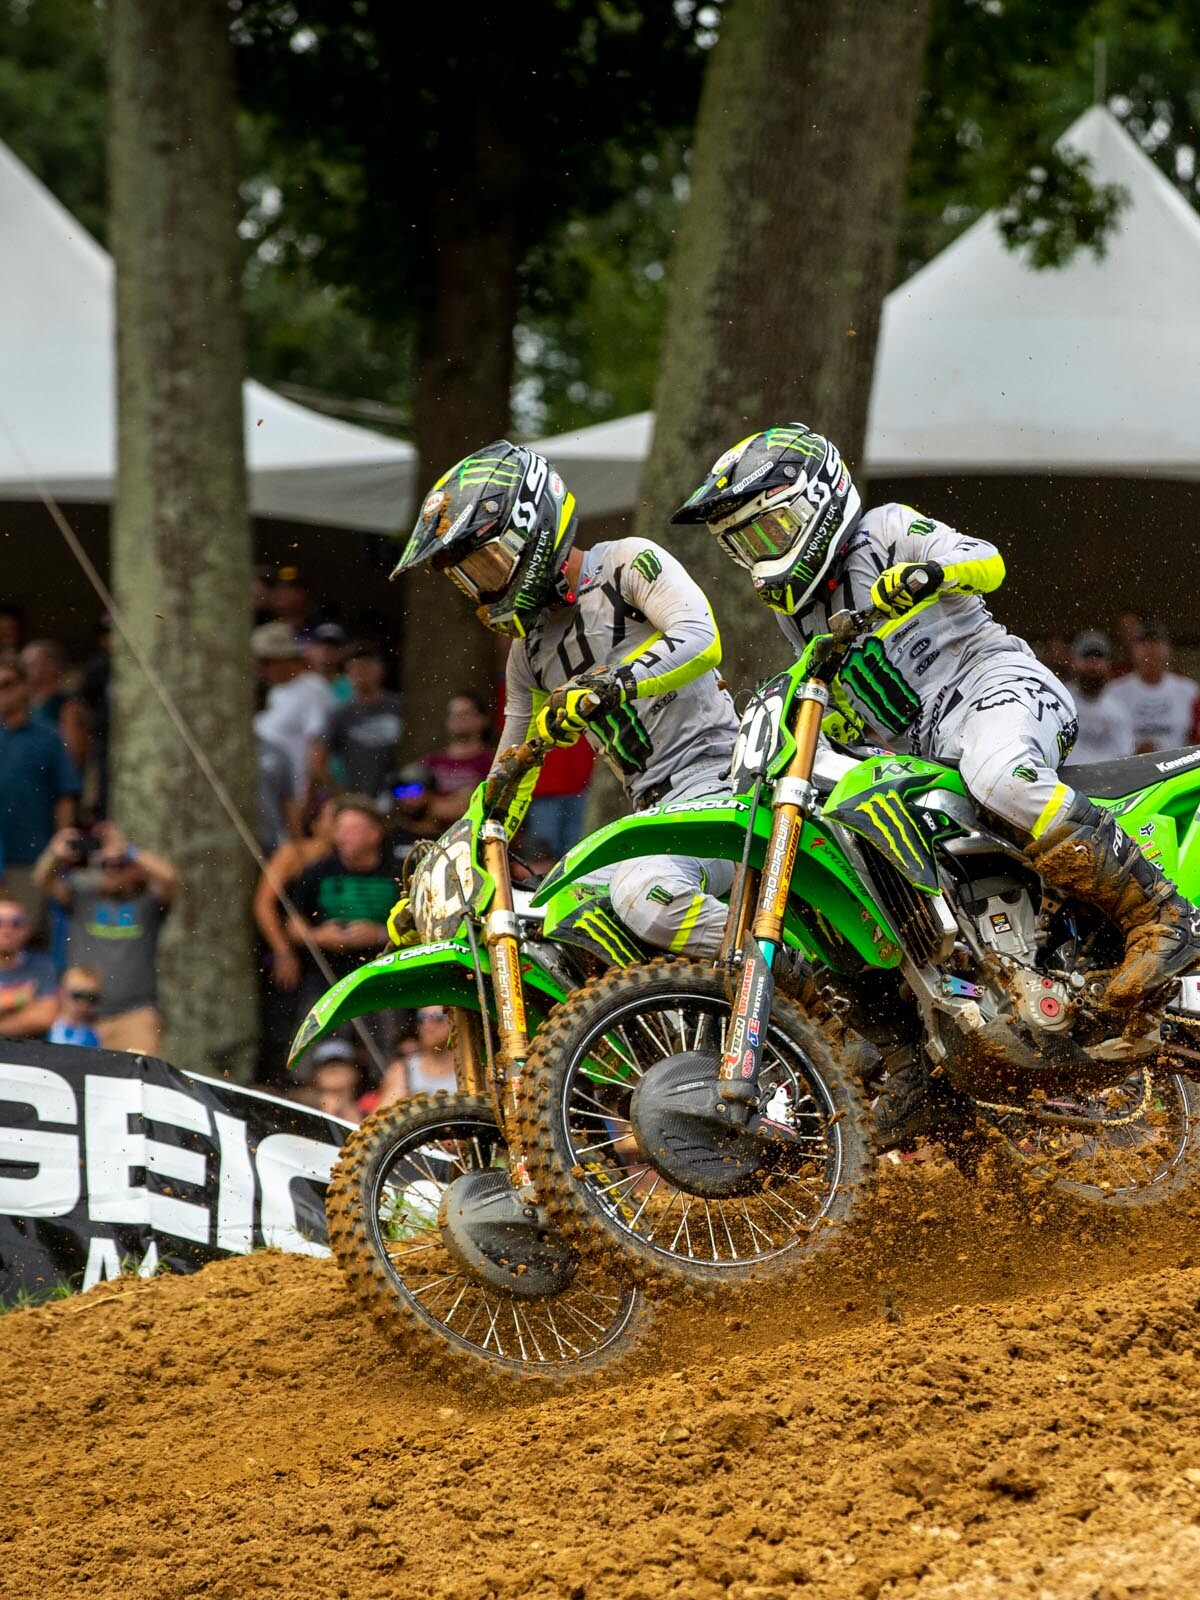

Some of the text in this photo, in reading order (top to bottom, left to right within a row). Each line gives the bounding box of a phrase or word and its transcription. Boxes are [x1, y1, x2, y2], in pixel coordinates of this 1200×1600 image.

[522, 530, 550, 590] MONSTER
[804, 505, 838, 562] MONSTER
[912, 640, 928, 656] BELL
[664, 799, 750, 813] CIRCUIT
[763, 814, 790, 912] PRO CIRCUIT
[785, 822, 800, 881] SHOWA
[399, 940, 471, 961] CIRCUIT
[510, 945, 522, 999] SHOWA
[738, 959, 755, 1015] BRAKING
[747, 976, 764, 1047] JE PISTONS
[0, 1063, 345, 1259] GEIC
